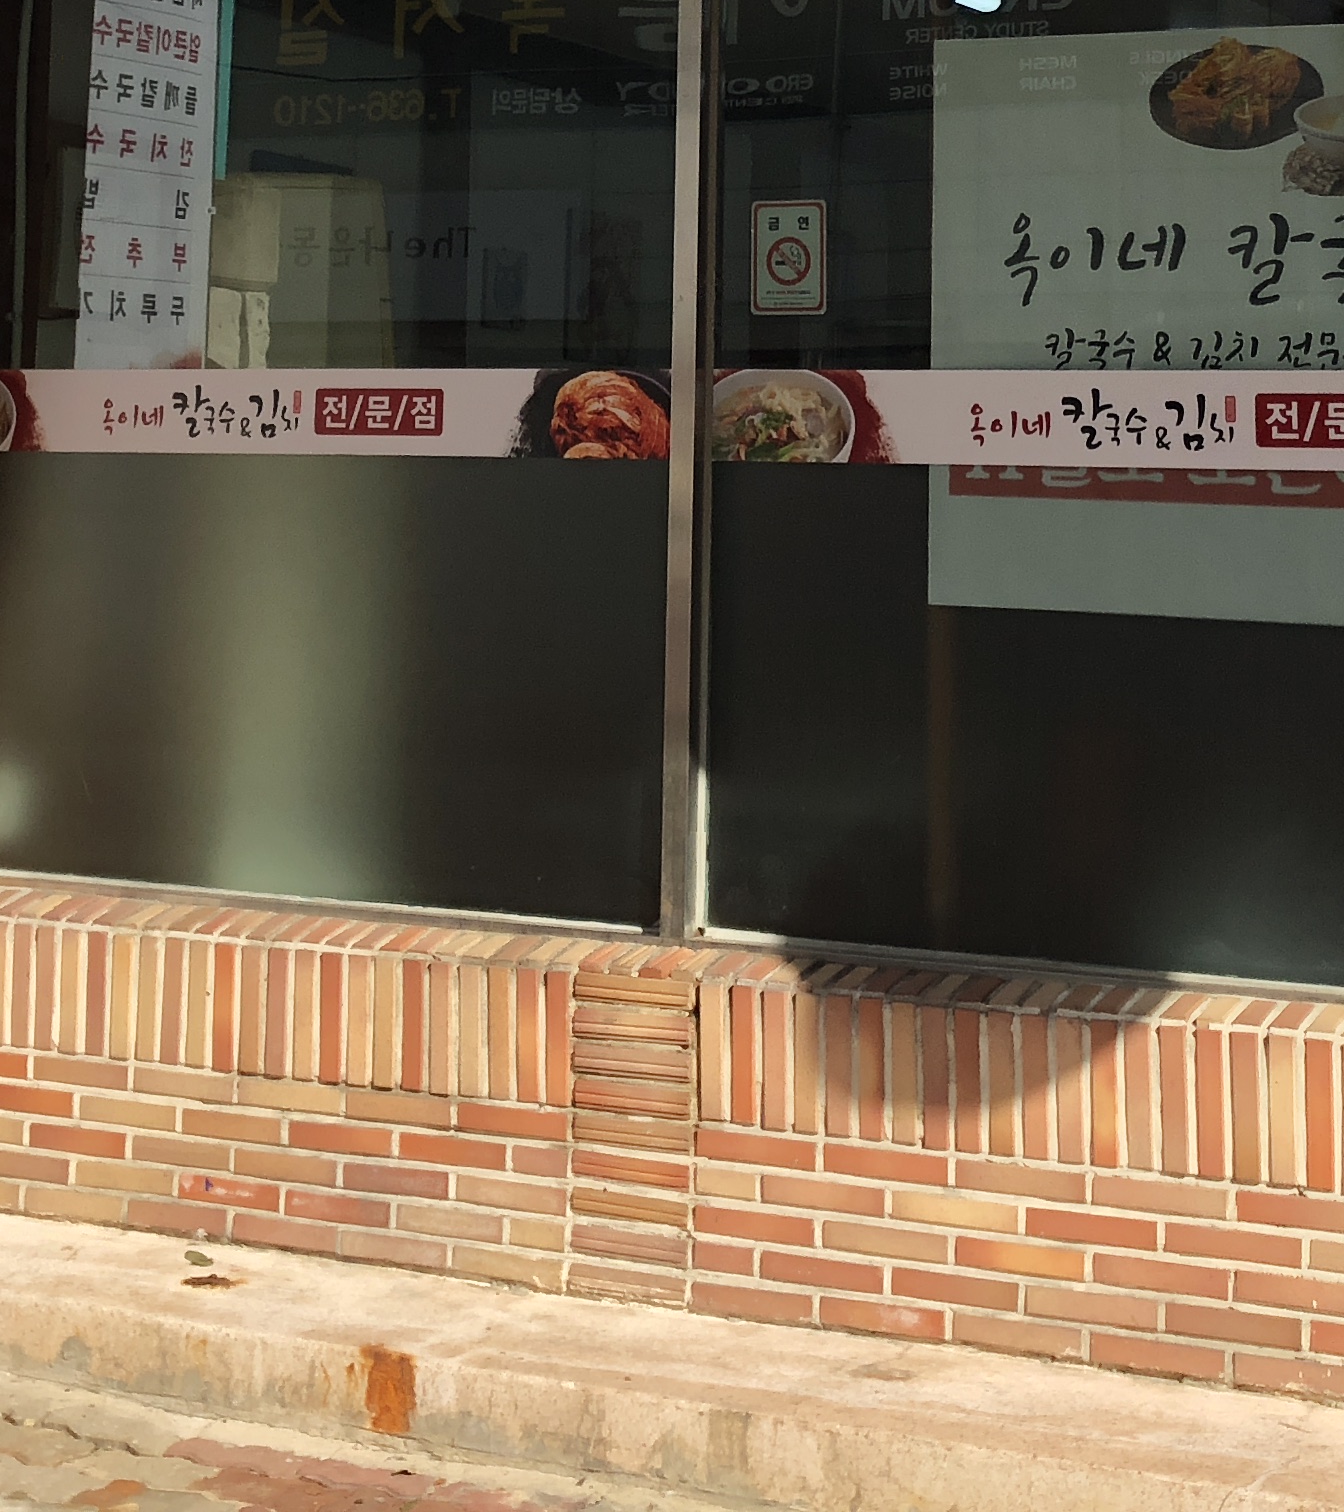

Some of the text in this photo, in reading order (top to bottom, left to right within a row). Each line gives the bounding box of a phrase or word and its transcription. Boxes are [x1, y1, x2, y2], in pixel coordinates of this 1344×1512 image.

[1003, 211, 1188, 309] 옥이네
[1045, 328, 1136, 370] 칼국수
[1153, 331, 1172, 362] &
[1190, 331, 1259, 370] 김치
[102, 399, 164, 432] 옥이네
[322, 393, 438, 431] 전/문/점
[968, 402, 1051, 445] 옥이네
